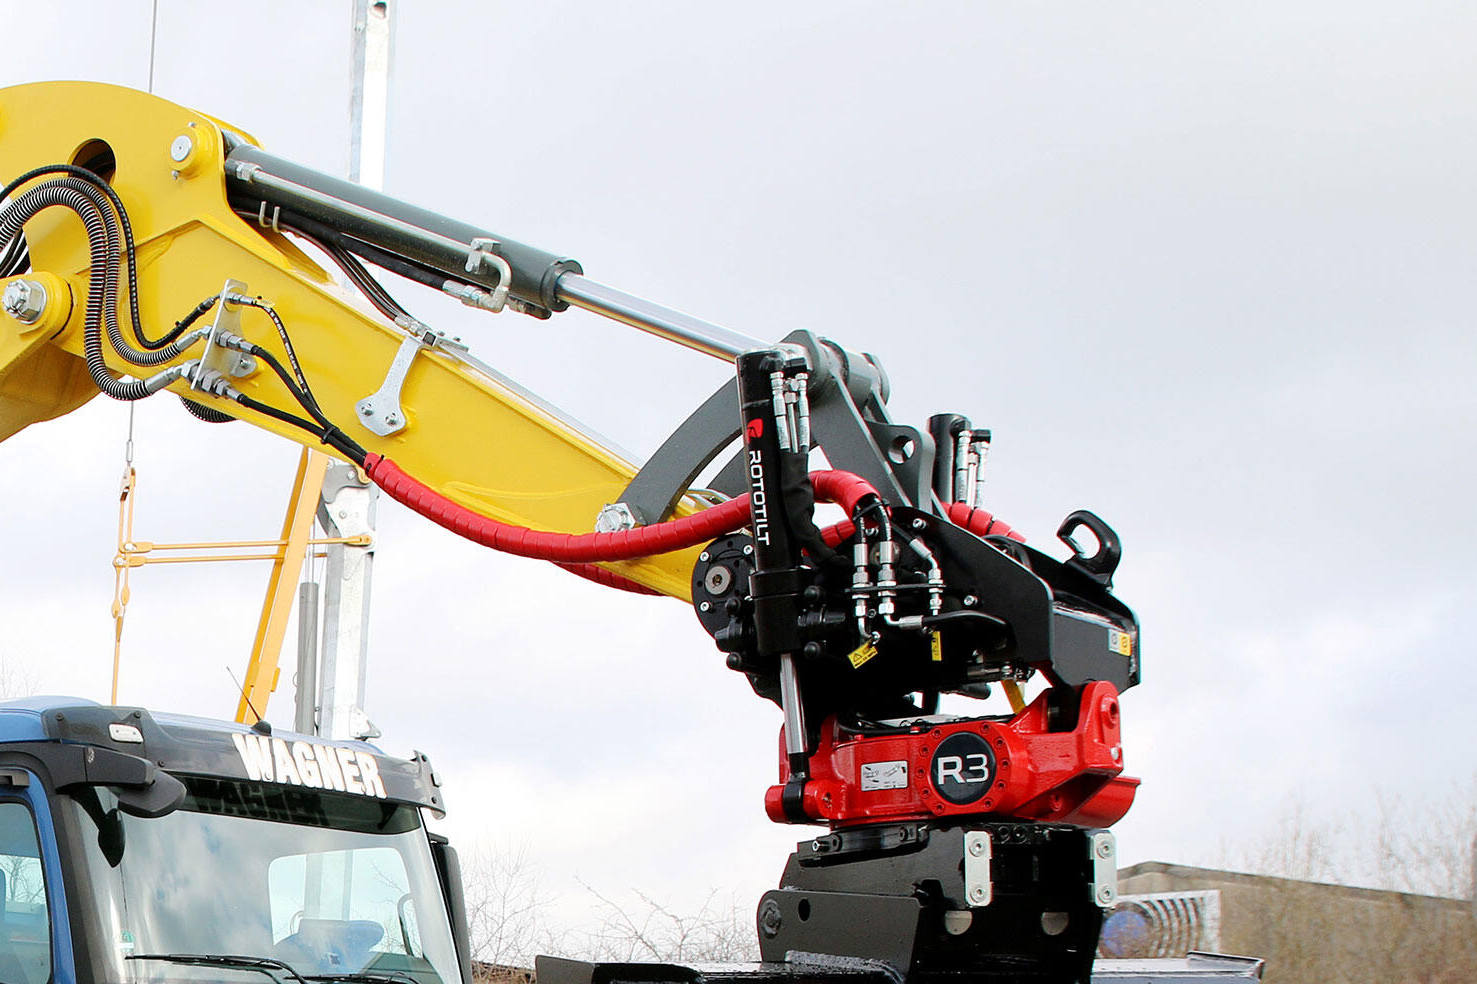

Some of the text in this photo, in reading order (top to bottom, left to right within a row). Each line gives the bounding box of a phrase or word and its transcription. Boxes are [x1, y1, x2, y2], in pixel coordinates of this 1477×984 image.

[748, 450, 770, 546] ROTOTILT
[231, 733, 388, 799] WAGNER
[937, 753, 990, 785] R3
